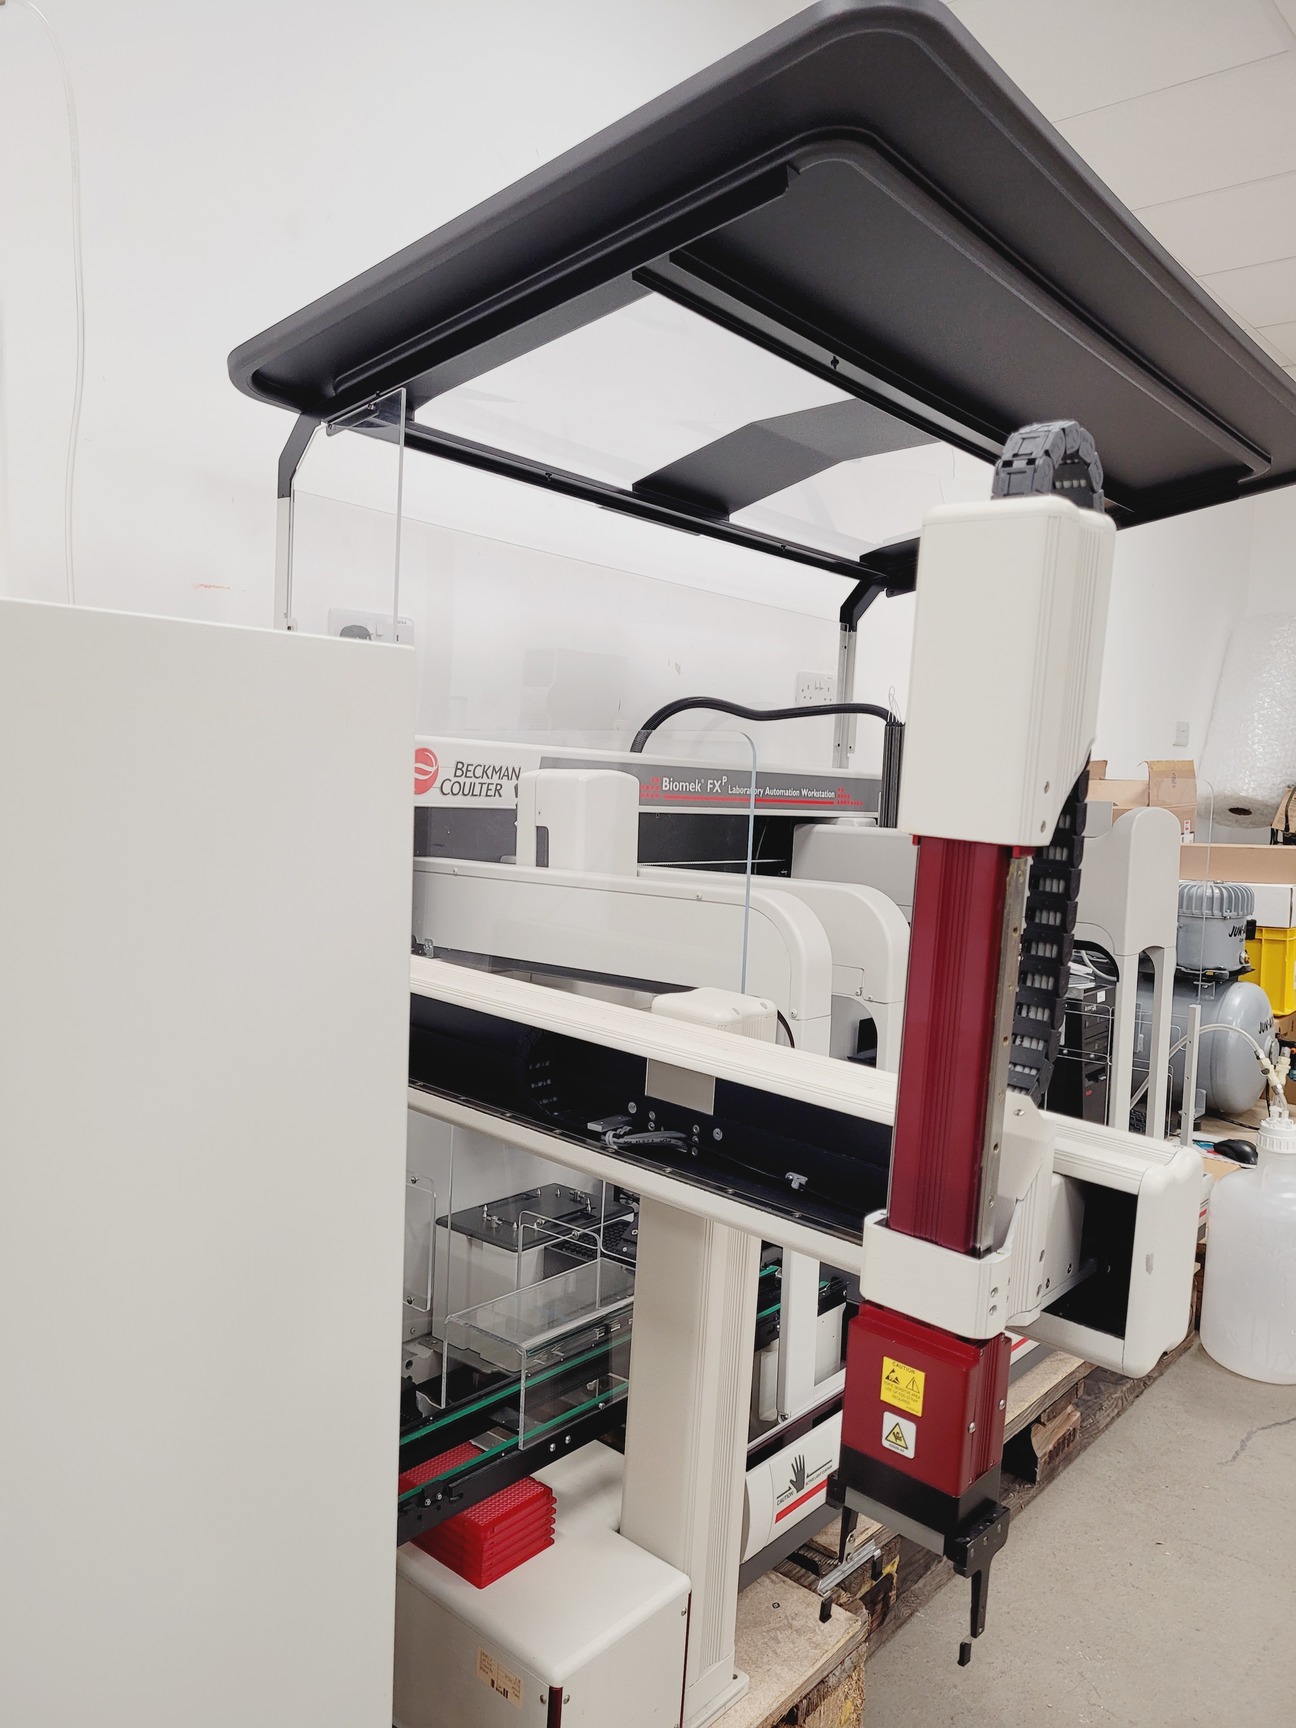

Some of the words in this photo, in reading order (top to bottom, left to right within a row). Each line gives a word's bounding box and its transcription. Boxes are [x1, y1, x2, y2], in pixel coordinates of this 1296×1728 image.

[453, 761, 521, 781] BECKMAN
[440, 778, 503, 798] COULTER
[728, 784, 764, 797] Laboraory
[765, 786, 800, 797] Automation
[801, 788, 836, 798] Workstation
[892, 1361, 915, 1374] CAUTION
